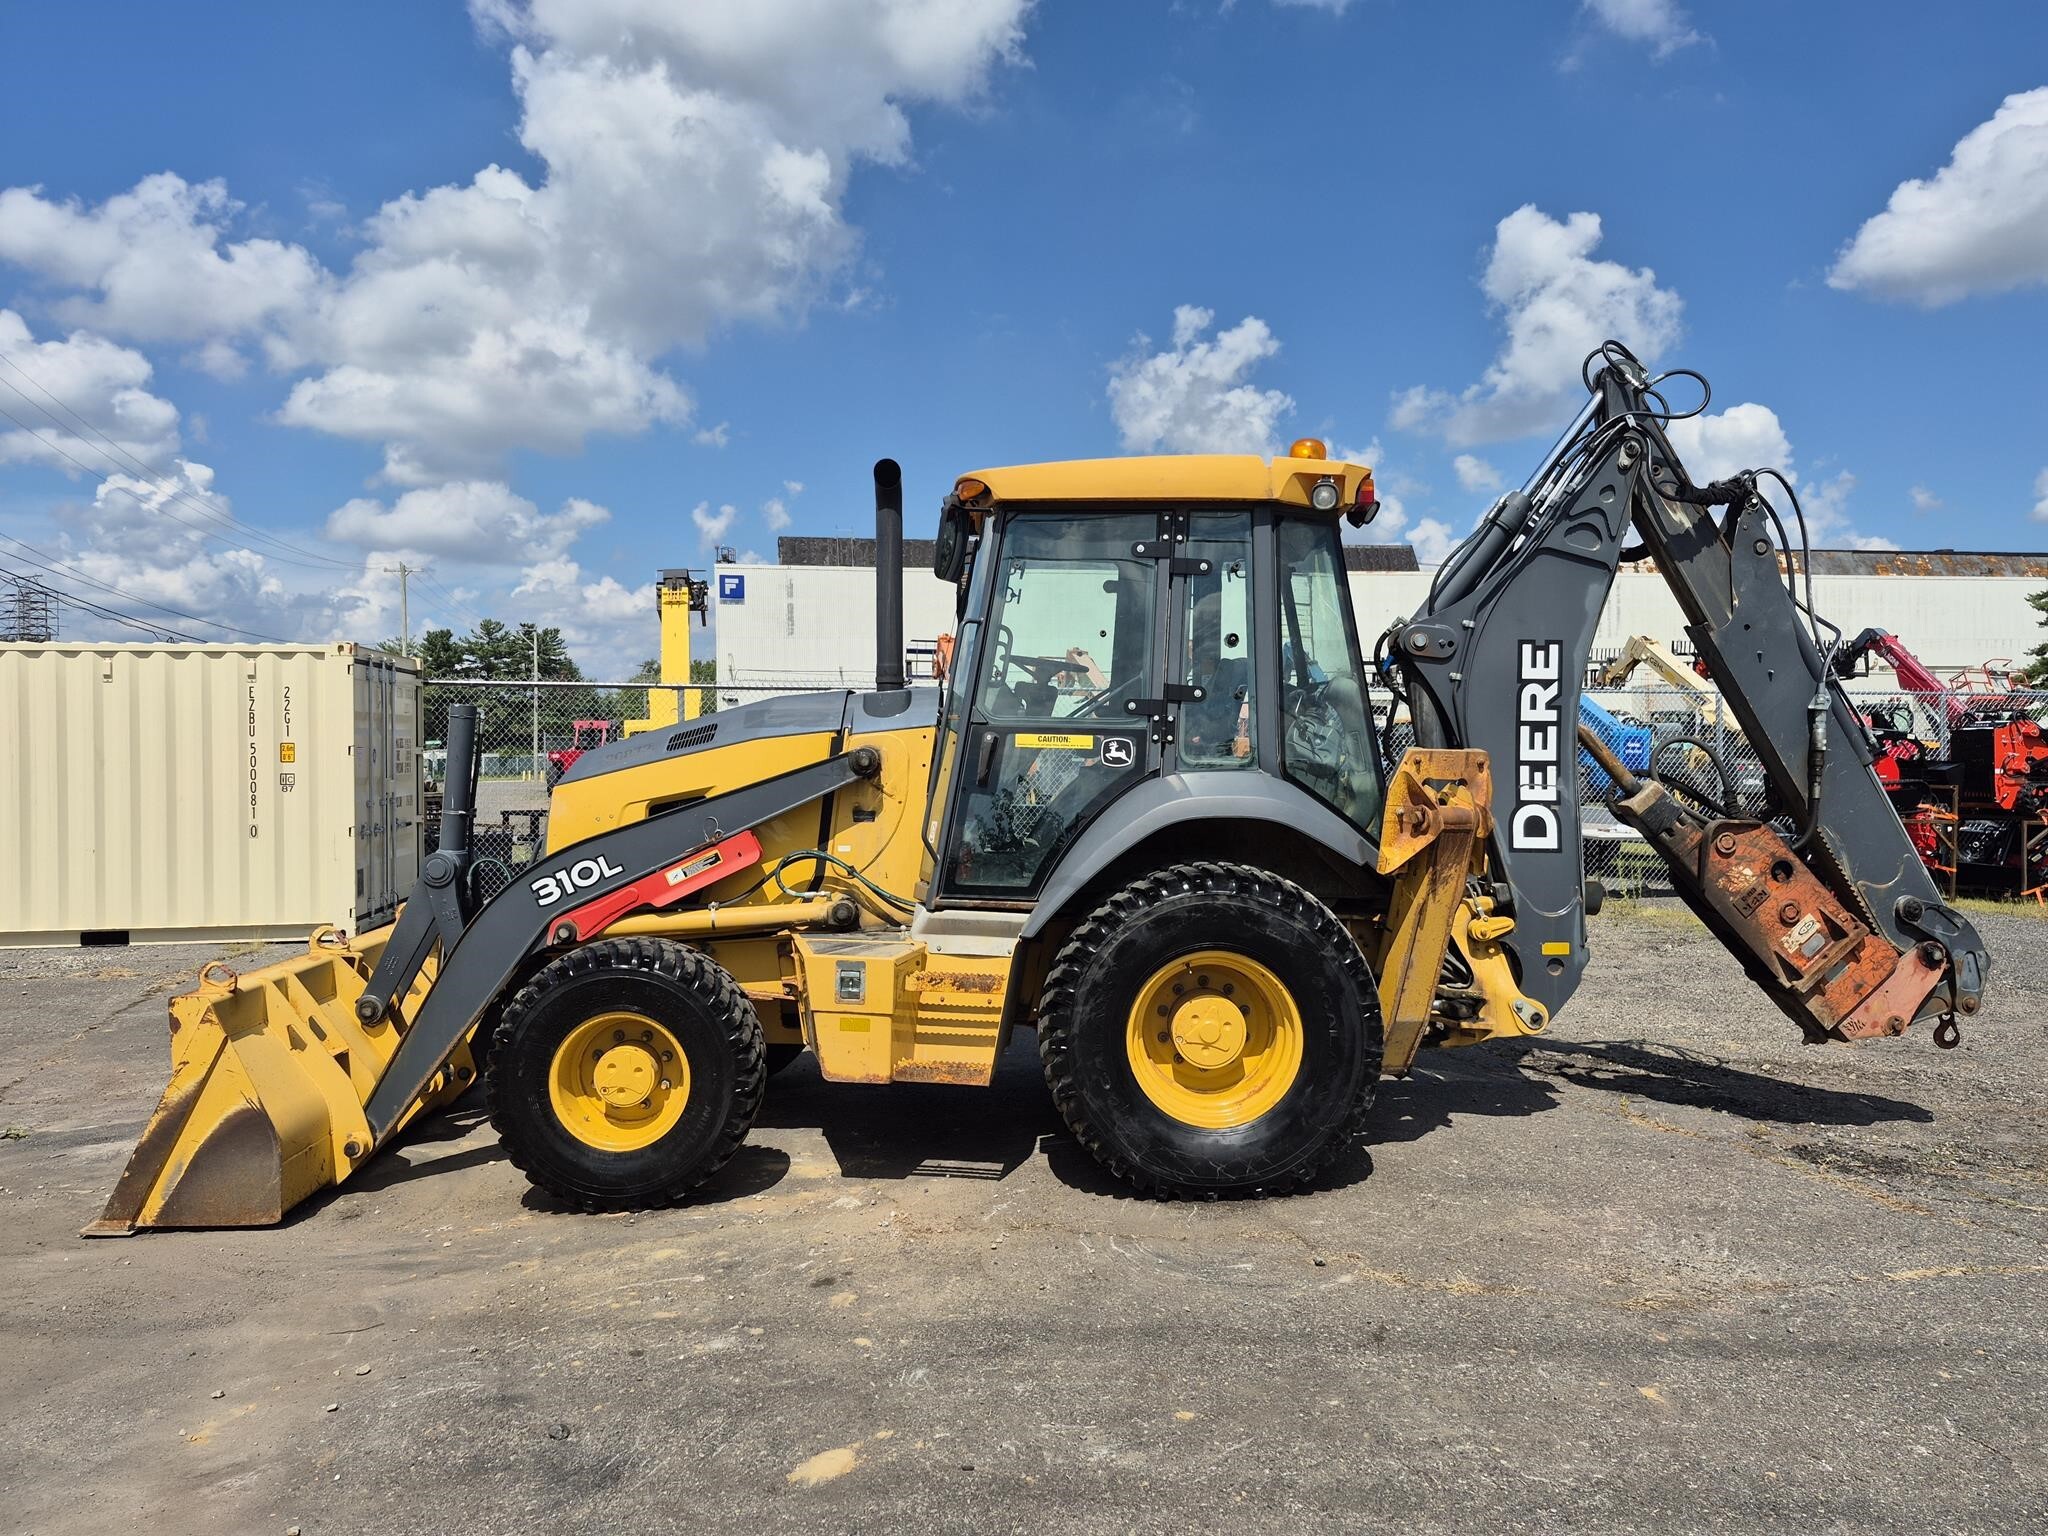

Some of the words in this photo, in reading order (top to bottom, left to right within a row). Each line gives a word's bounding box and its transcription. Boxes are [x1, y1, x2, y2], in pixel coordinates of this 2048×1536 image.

[724, 577, 739, 595] F
[248, 686, 256, 737] EZBU
[283, 686, 291, 737] 22G1
[1037, 735, 1072, 744] CAUTION:
[1512, 643, 1560, 849] DEERE
[249, 742, 257, 819] 500081
[250, 824, 258, 838] 0
[530, 855, 625, 907] 310L
